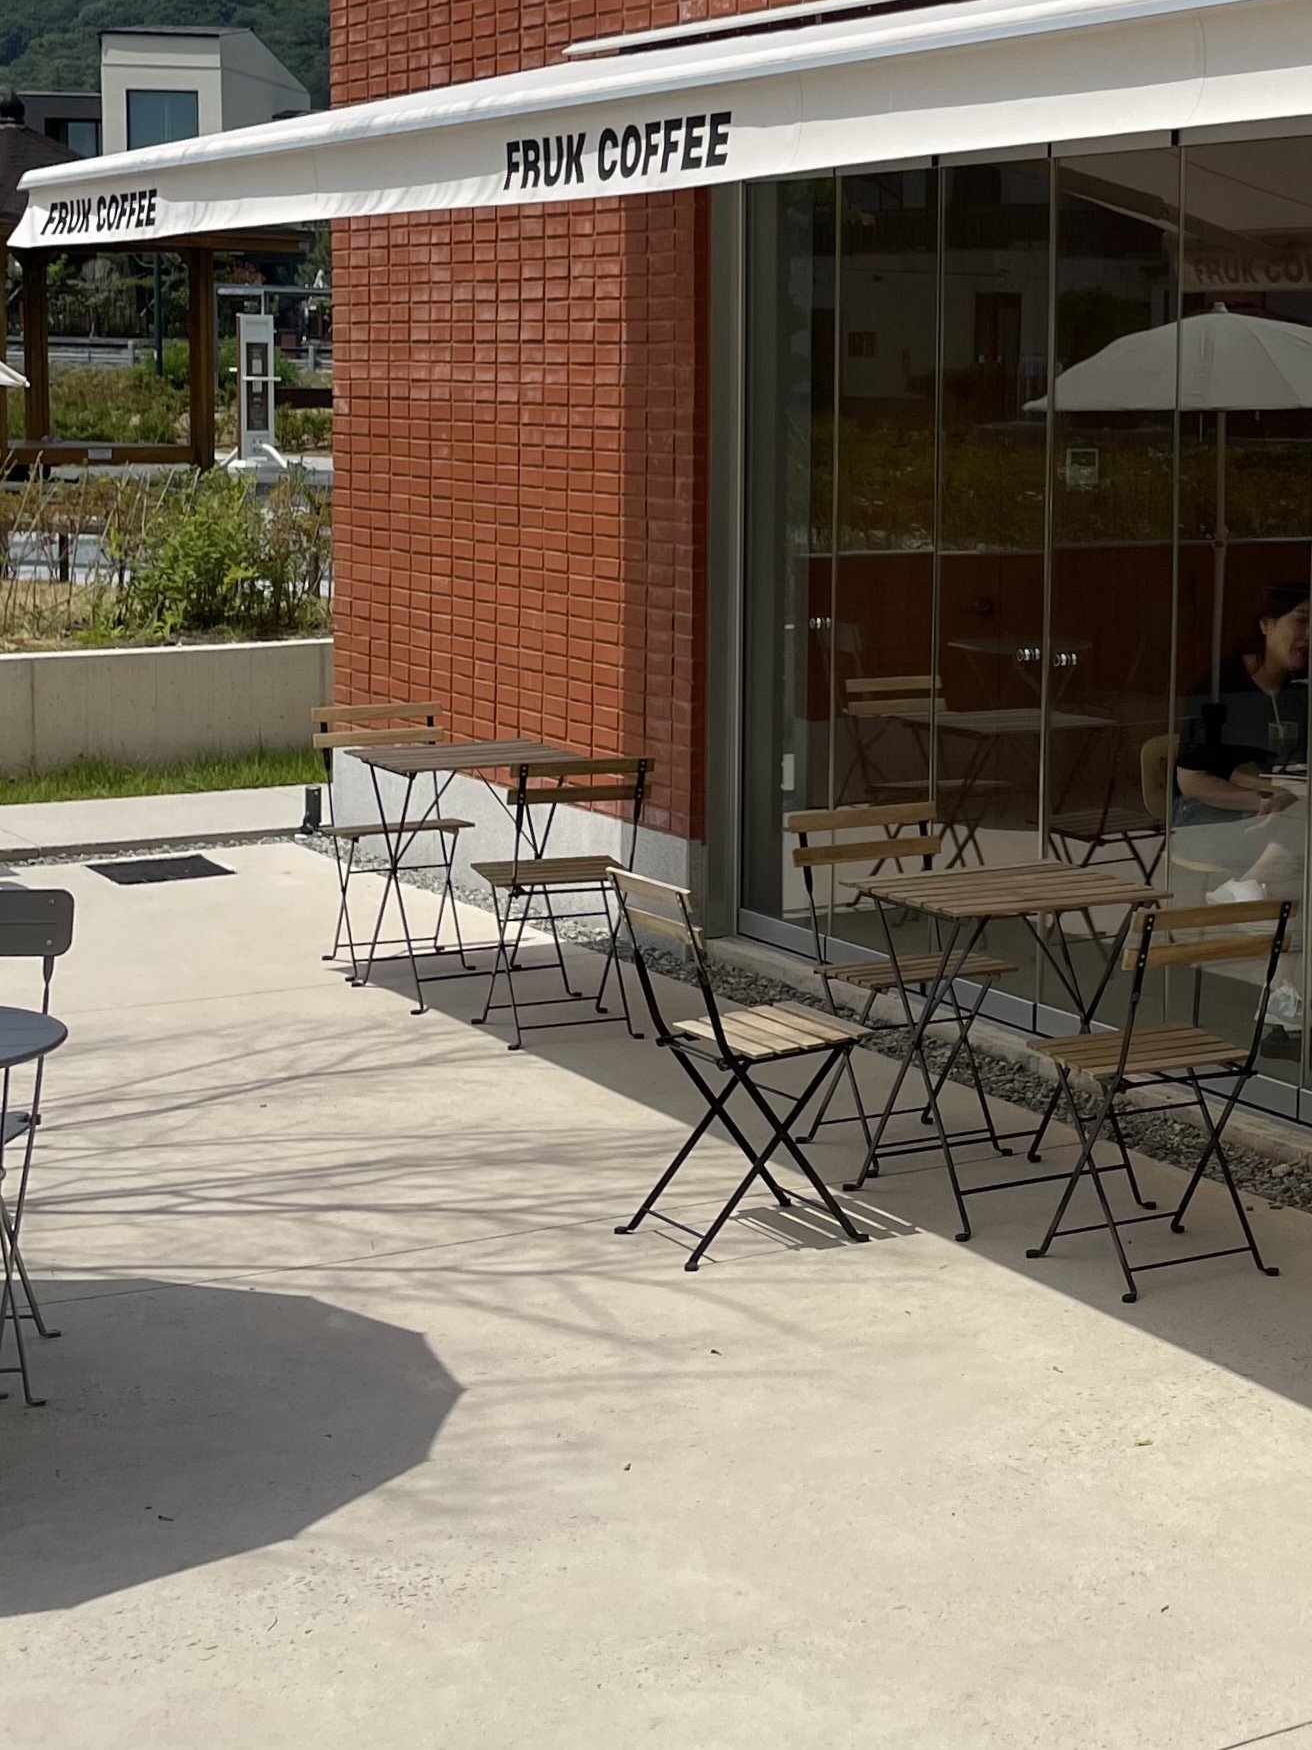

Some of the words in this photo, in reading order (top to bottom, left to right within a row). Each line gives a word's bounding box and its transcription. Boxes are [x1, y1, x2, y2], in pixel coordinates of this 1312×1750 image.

[503, 131, 587, 191] FRUK
[598, 110, 732, 182] COFFEE
[40, 197, 92, 236] FRUK
[96, 188, 158, 233] COFFEE
